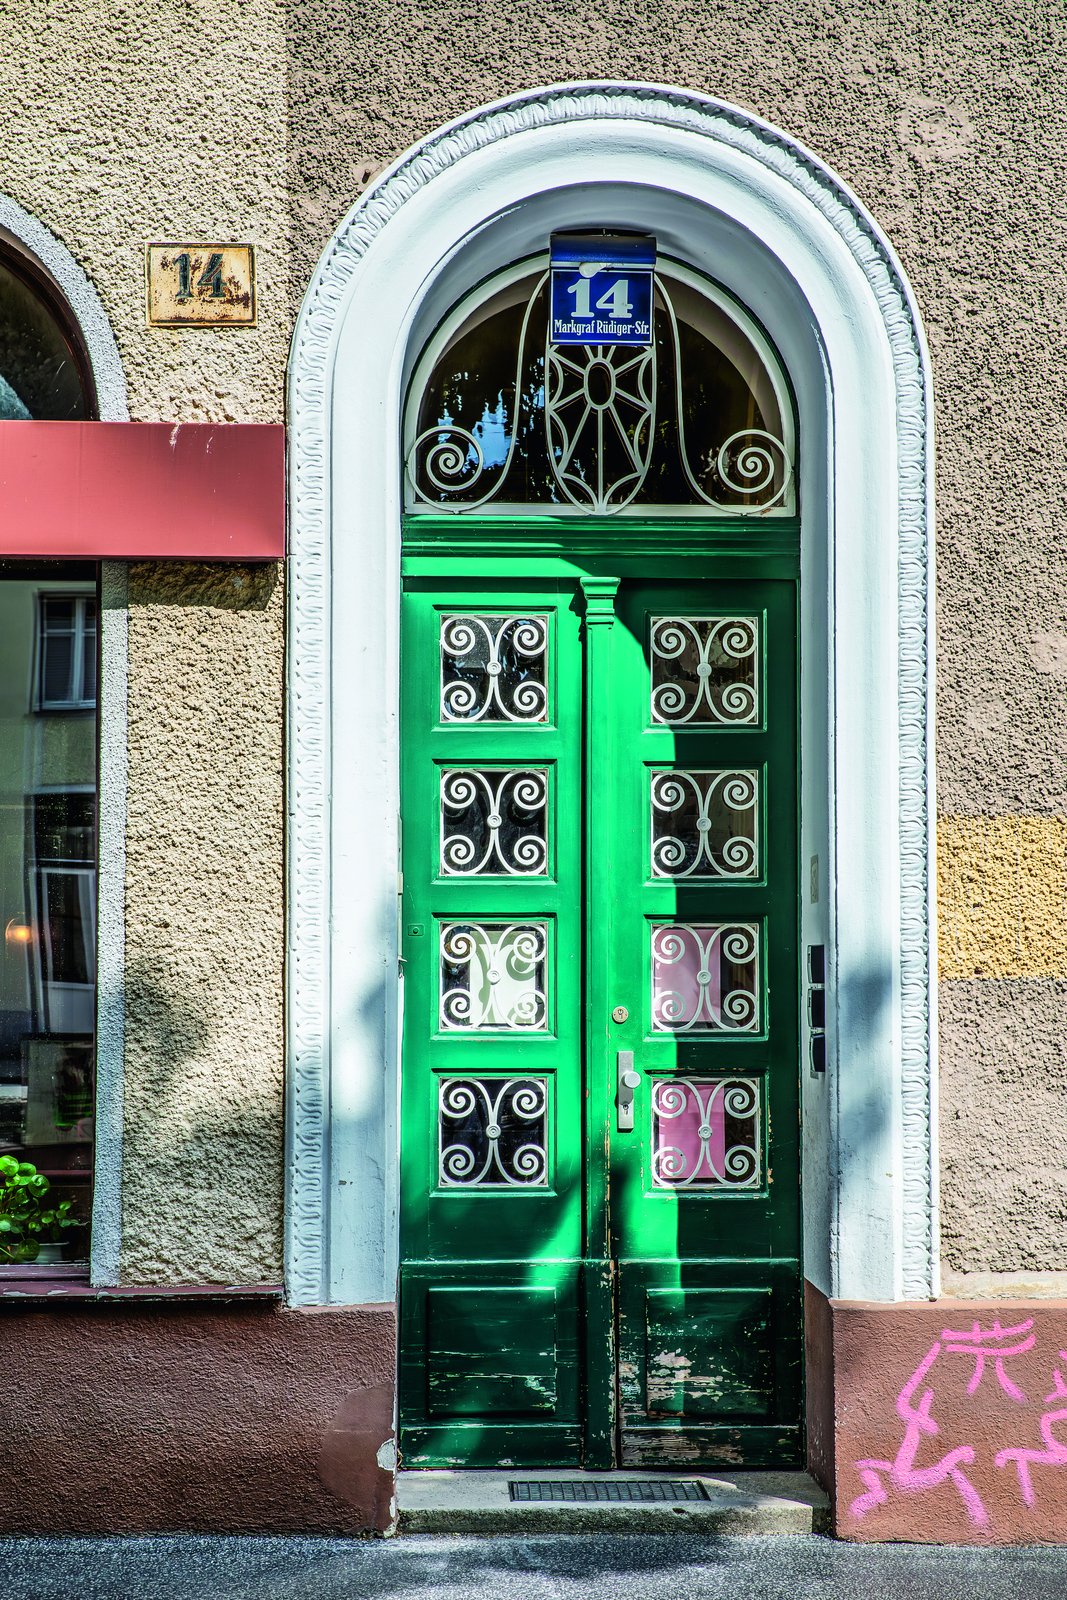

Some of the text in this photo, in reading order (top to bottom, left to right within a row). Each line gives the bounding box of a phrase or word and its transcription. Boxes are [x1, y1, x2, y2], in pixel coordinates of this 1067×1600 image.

[172, 253, 227, 298] 14
[567, 278, 634, 319] 14
[554, 319, 650, 336] Markgraf Rüdiger-Str.
